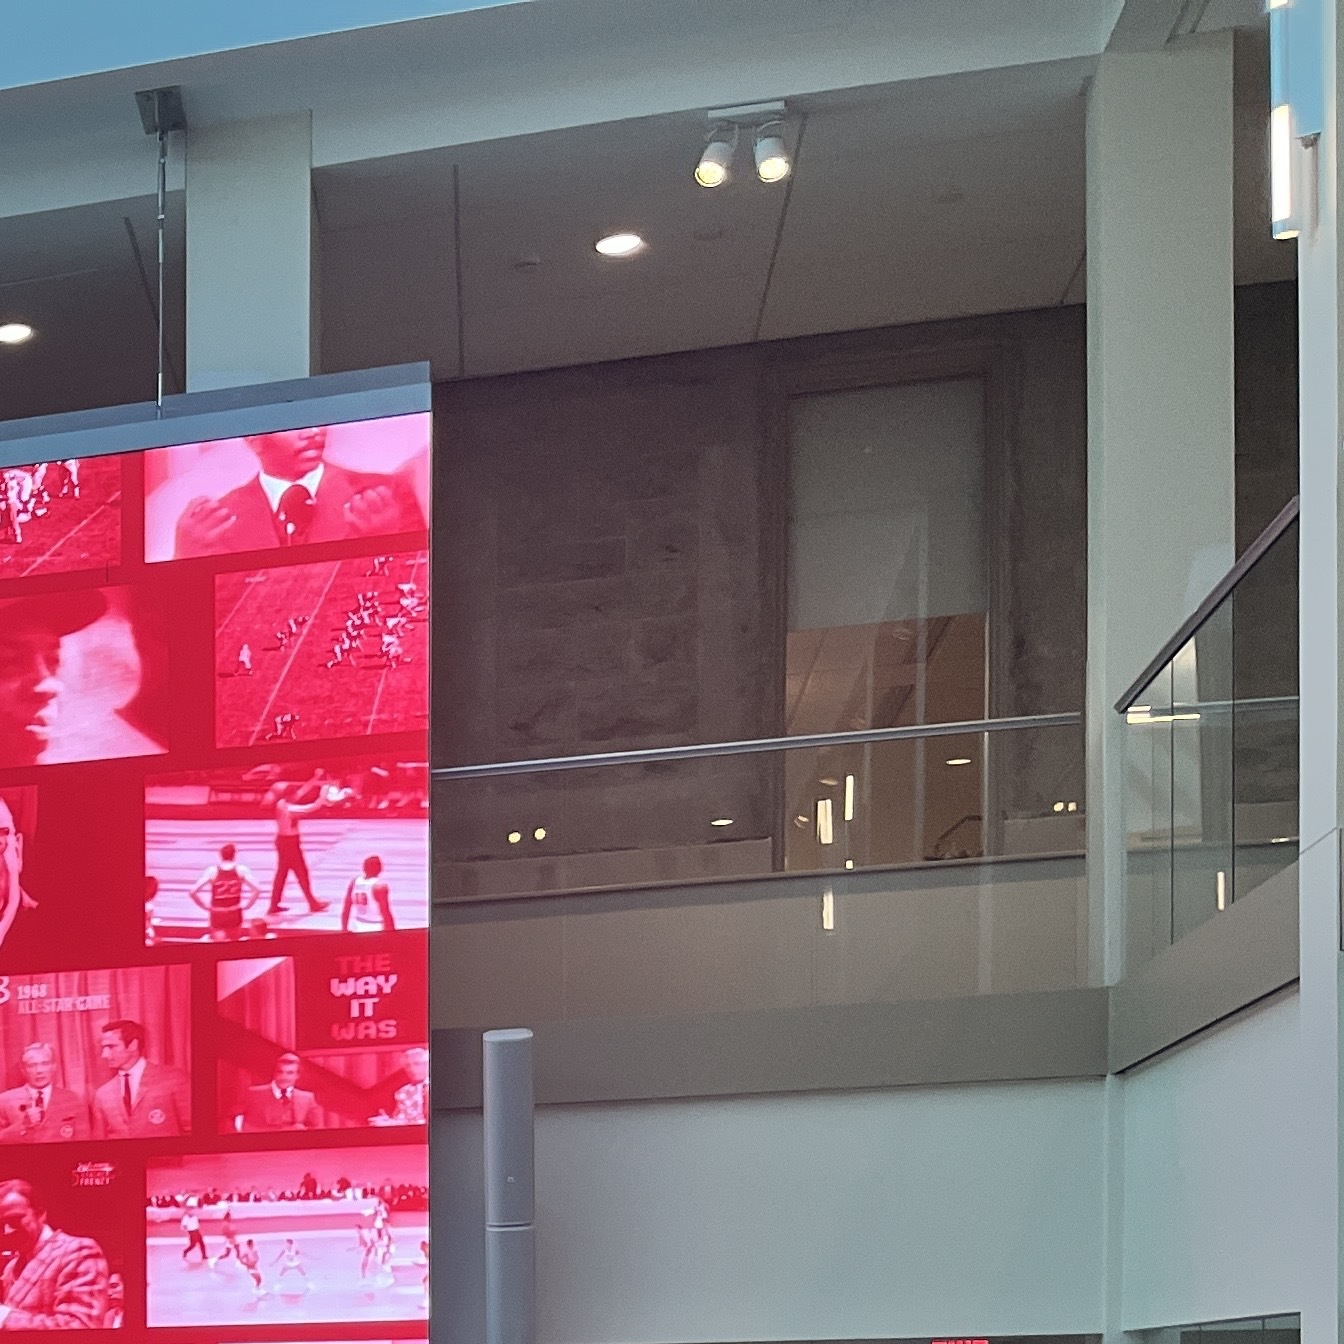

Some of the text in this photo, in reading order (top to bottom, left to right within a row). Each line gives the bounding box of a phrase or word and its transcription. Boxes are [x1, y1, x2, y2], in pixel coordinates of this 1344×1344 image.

[335, 953, 391, 975] THE
[330, 974, 398, 997] WAY
[350, 997, 380, 1018] IT
[331, 1020, 398, 1041] WAS
